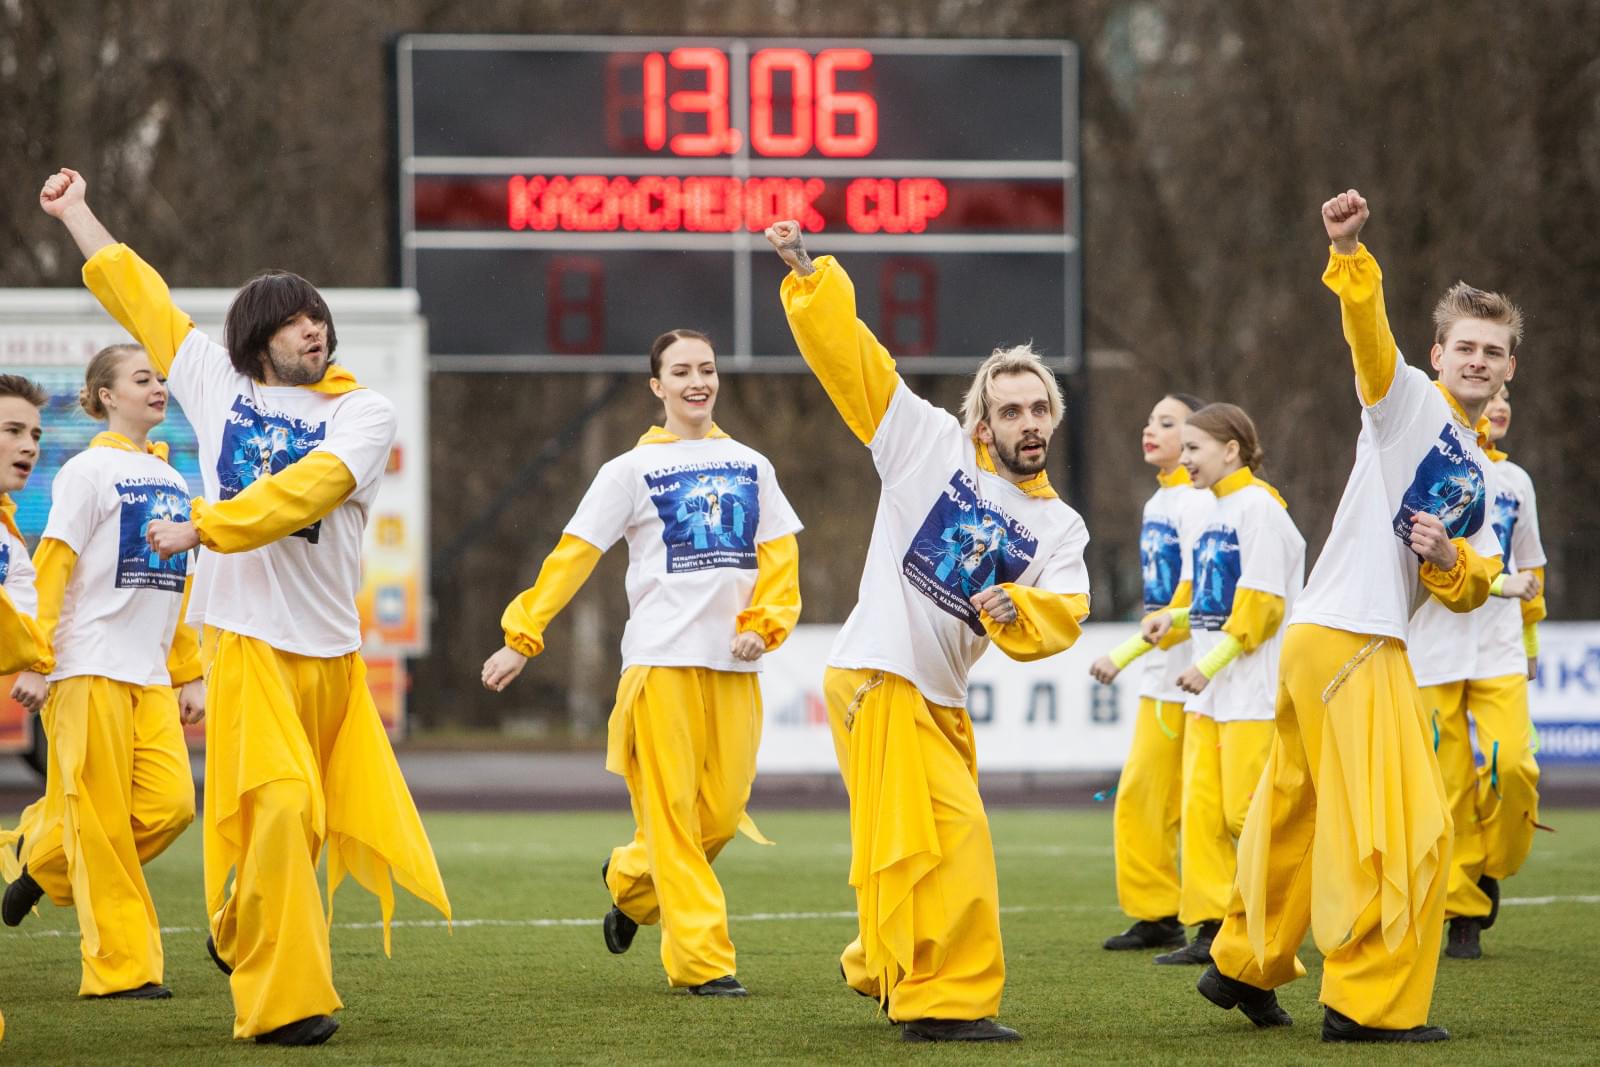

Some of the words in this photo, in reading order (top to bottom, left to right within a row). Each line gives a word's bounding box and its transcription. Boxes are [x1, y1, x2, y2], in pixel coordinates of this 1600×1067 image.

[508, 175, 825, 232] KAZACHENOK
[846, 178, 948, 233] CUP
[1014, 522, 1036, 543] CUP
